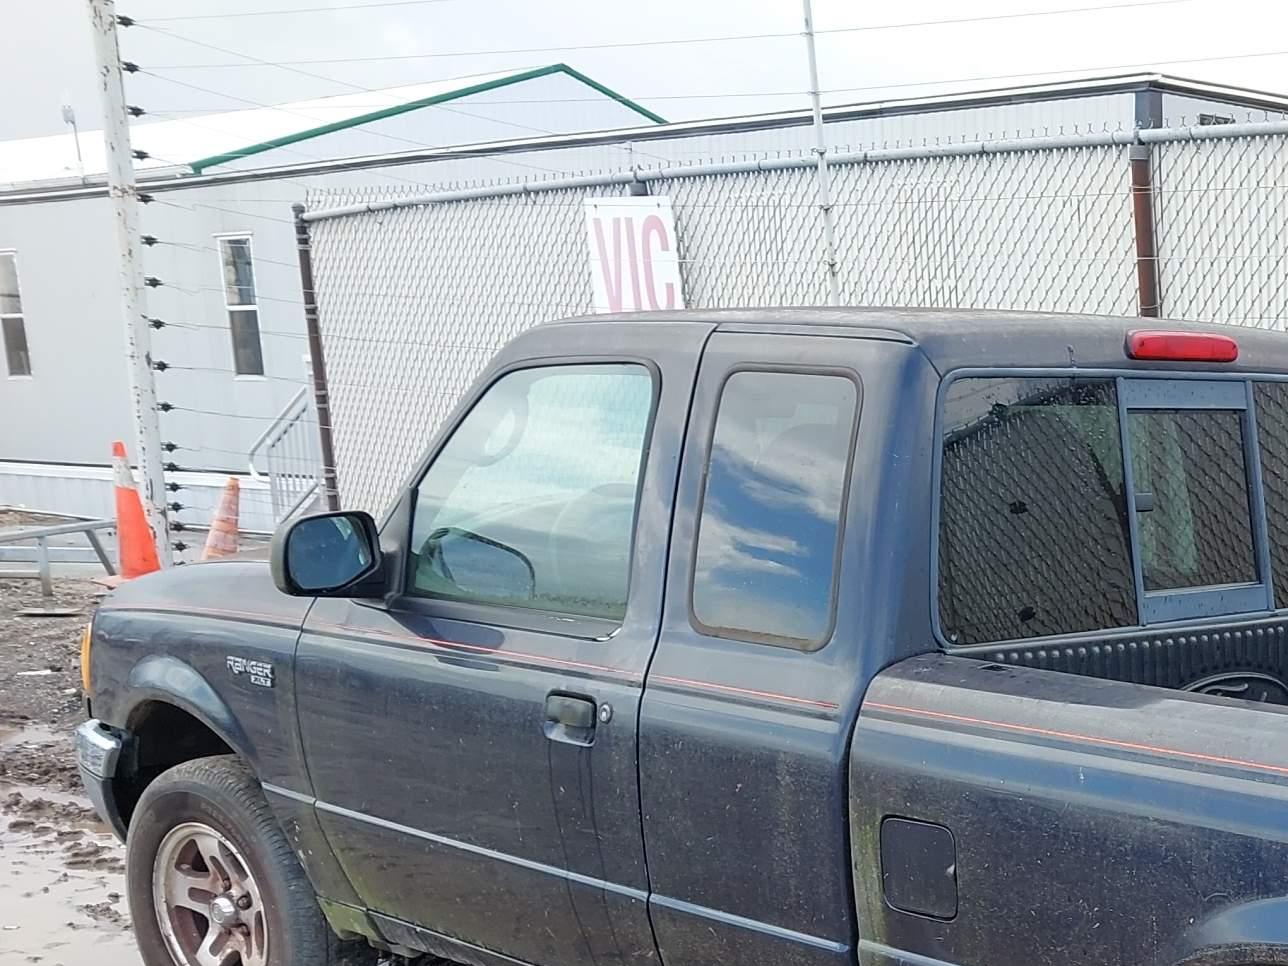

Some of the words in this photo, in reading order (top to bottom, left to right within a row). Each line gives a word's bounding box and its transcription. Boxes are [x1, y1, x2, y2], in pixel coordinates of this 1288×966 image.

[592, 214, 675, 313] VIC
[226, 655, 273, 677] RANGER
[251, 676, 271, 686] XLT
